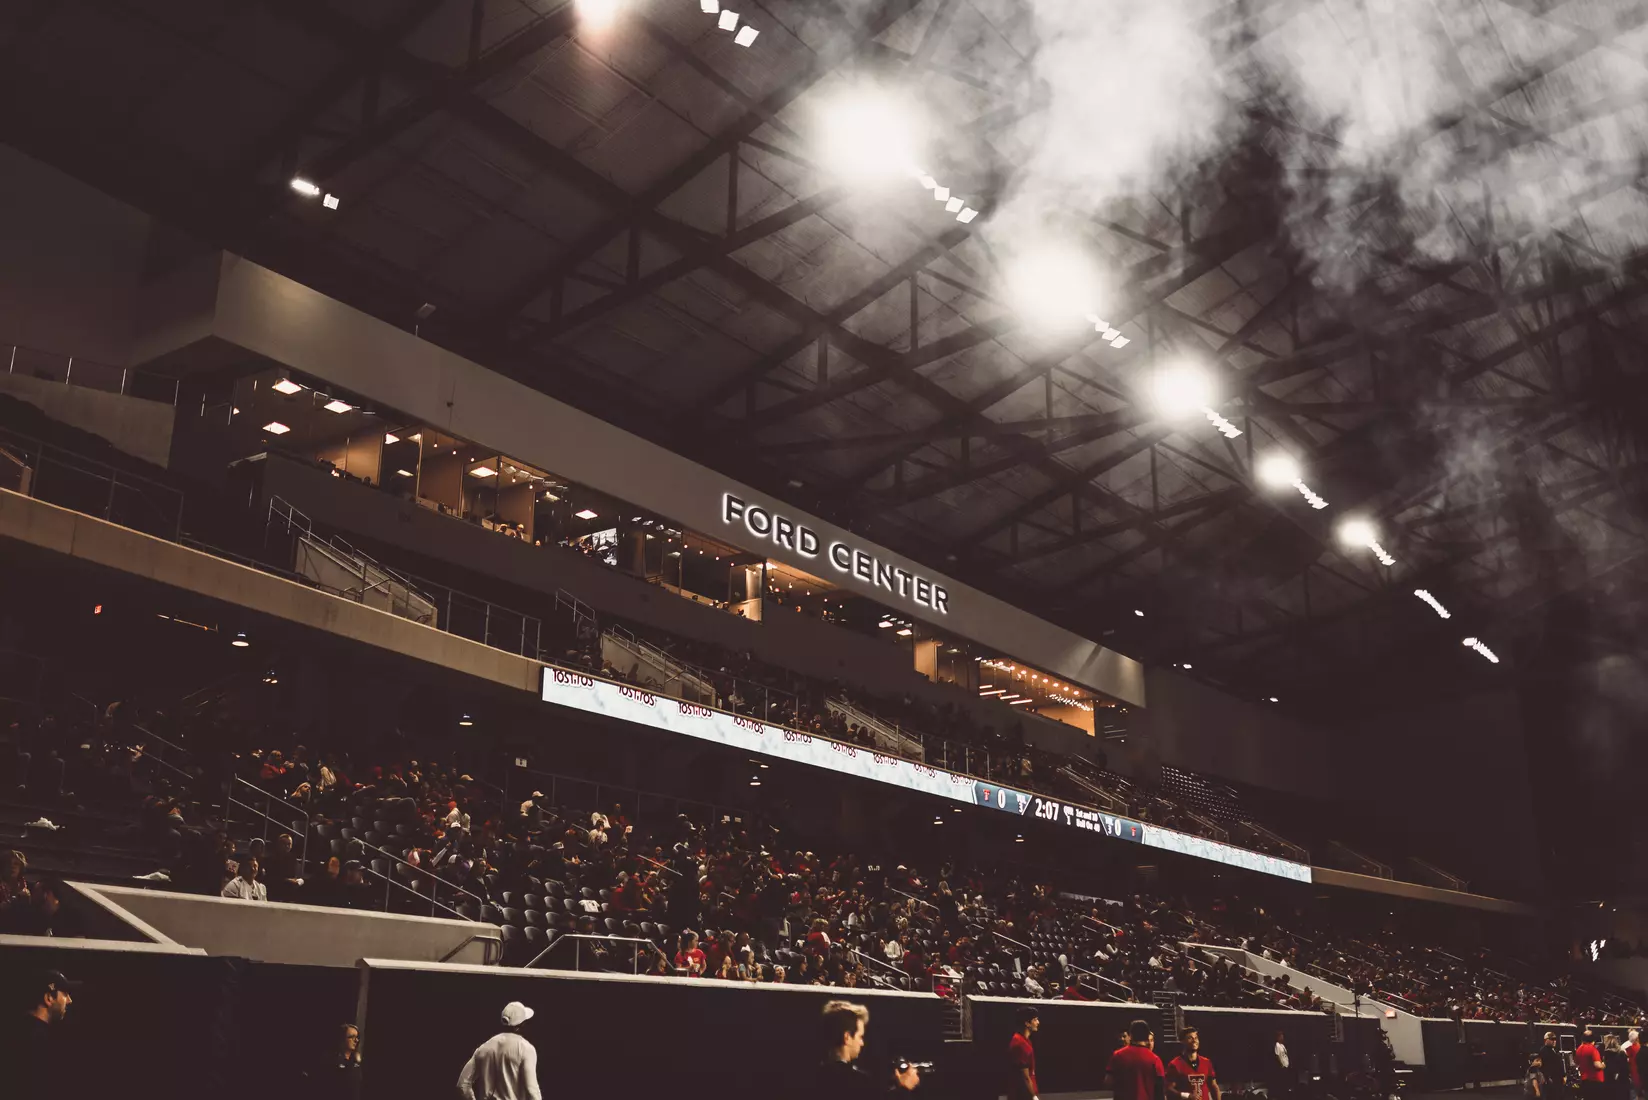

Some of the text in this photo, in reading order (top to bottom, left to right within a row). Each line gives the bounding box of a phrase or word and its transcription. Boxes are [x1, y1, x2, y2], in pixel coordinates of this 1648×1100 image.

[722, 492, 949, 615] FORD CENTER
[997, 789, 1006, 809] 0
[1035, 798, 1060, 821] 2:07
[1114, 818, 1122, 837] 0
